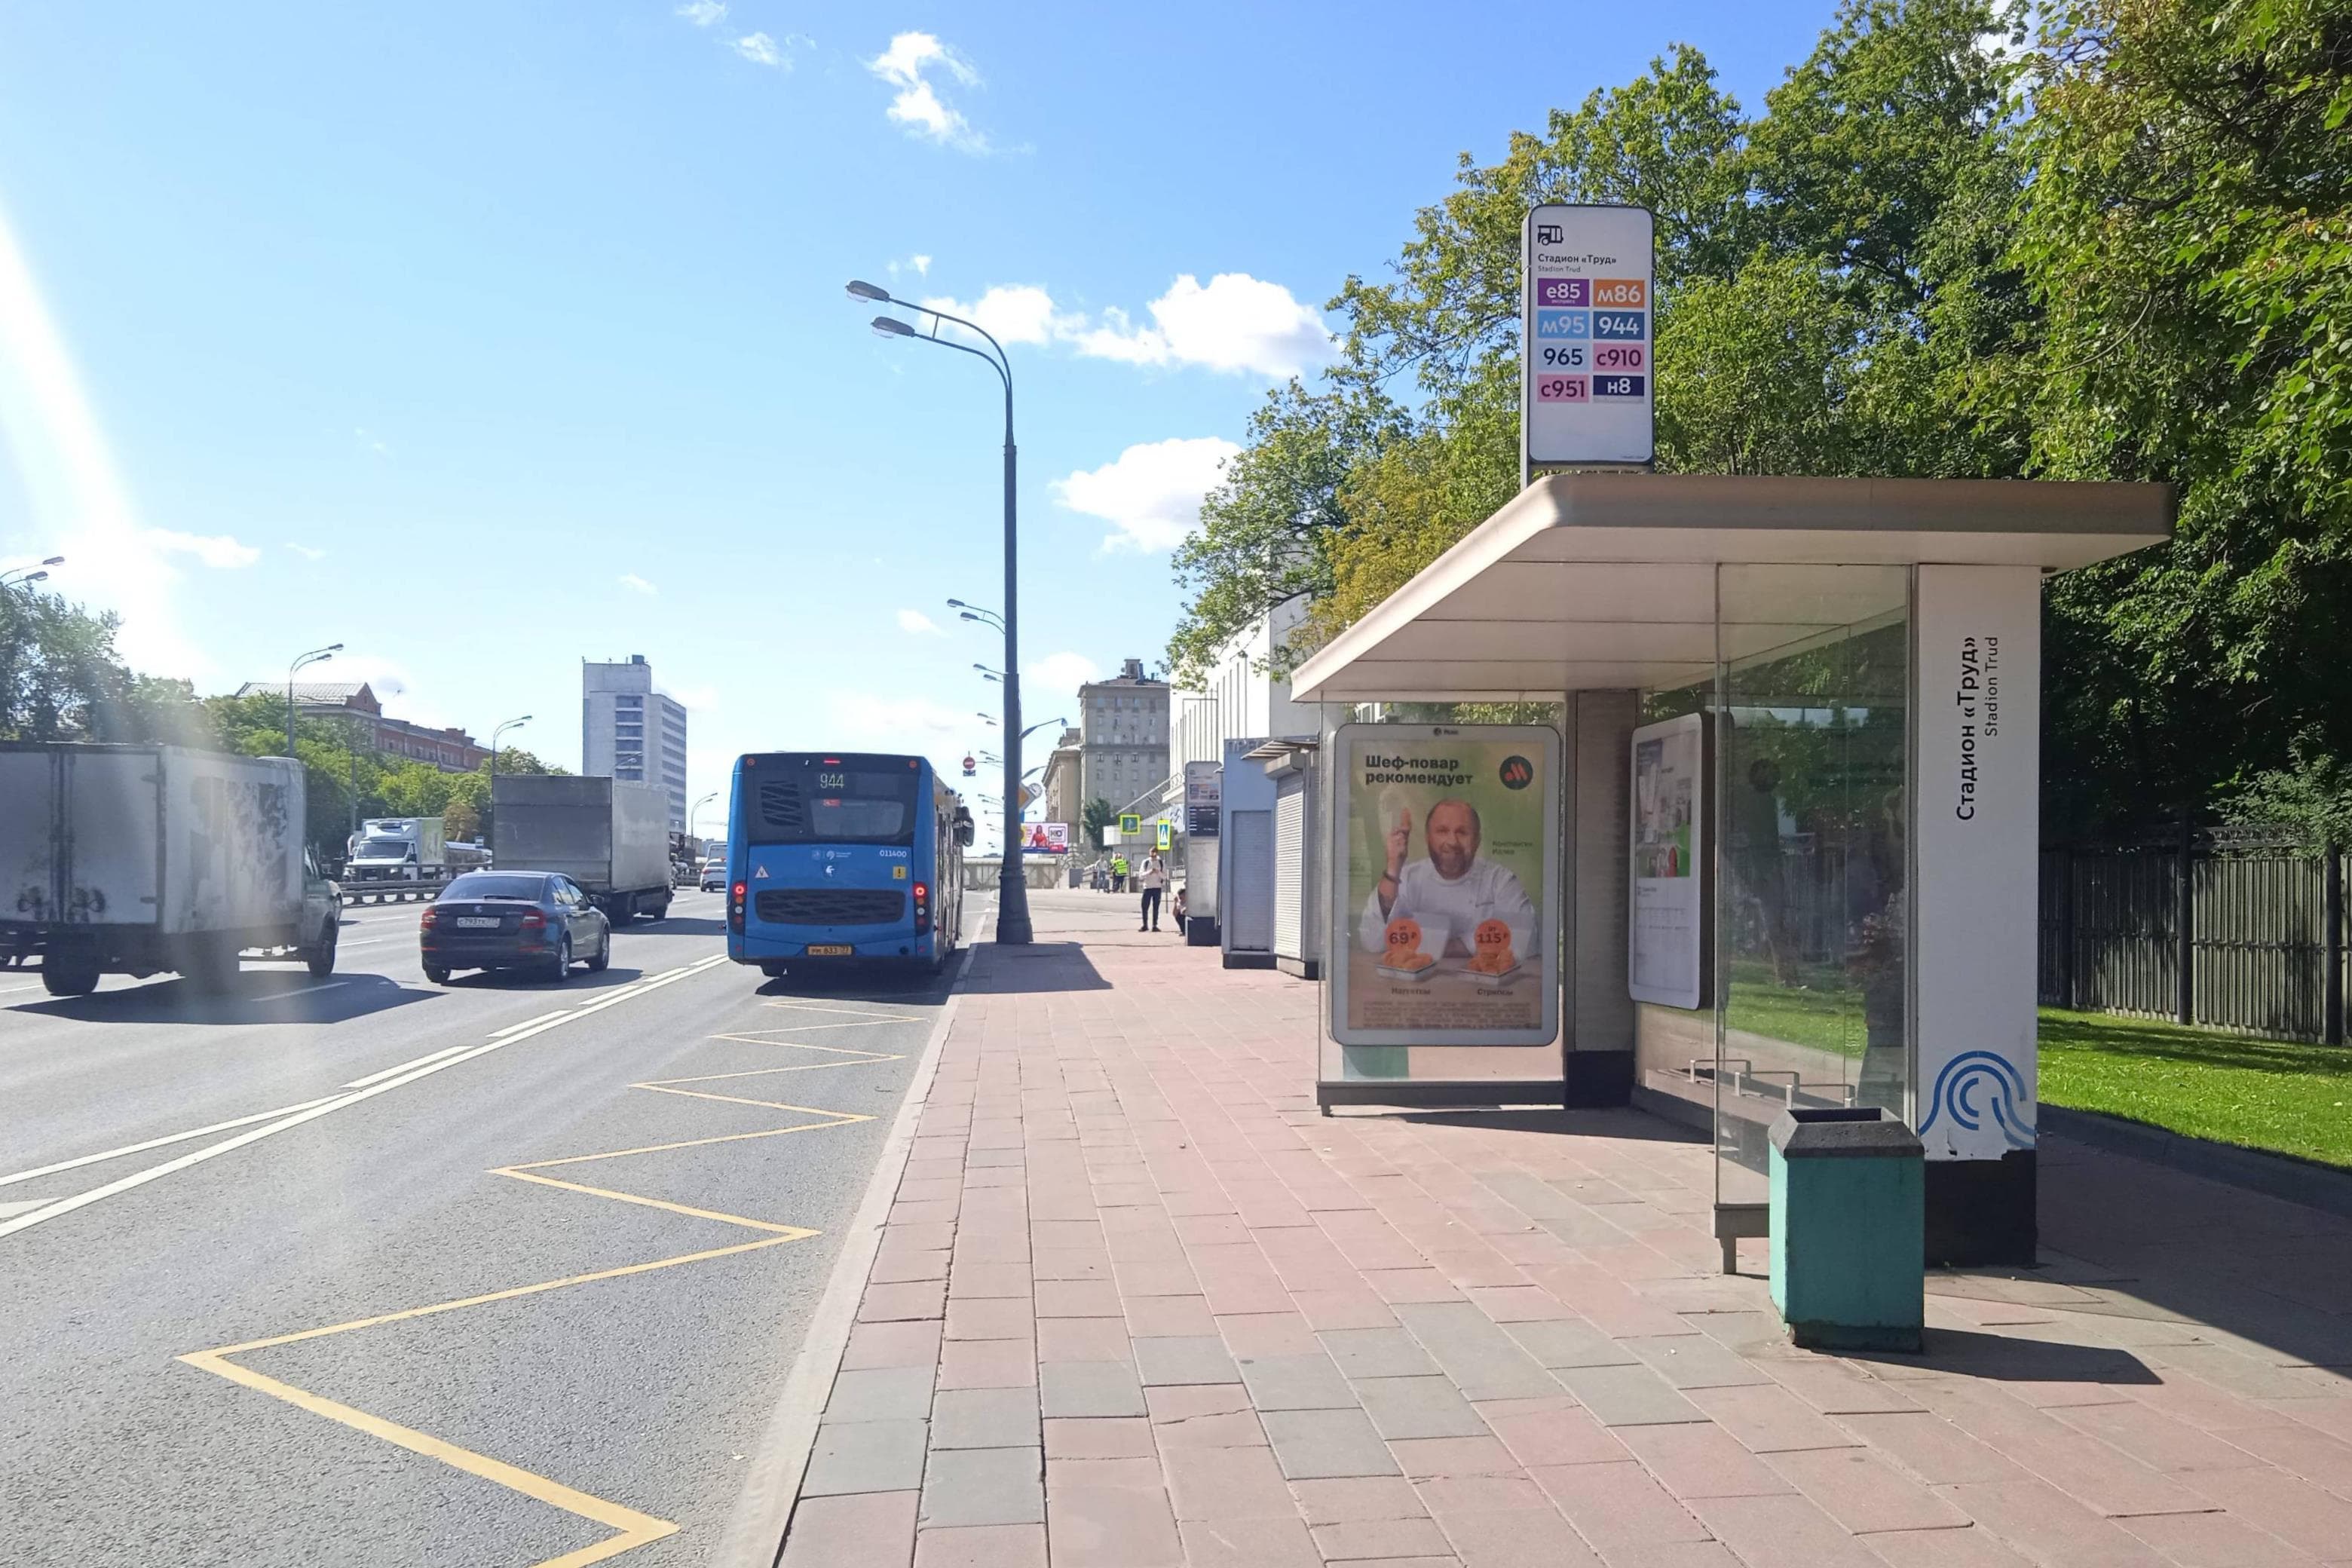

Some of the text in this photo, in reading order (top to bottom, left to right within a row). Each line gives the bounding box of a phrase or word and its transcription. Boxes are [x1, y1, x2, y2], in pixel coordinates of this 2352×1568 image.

[1538, 253, 1617, 265] Стадион «Труд»
[1598, 317, 1640, 335] 944
[1543, 348, 1583, 366] 965
[1984, 637, 1998, 737] Stadion Trud
[1956, 637, 1980, 821] Стадион «Труд»
[1365, 755, 1459, 771] Шеф-повар
[820, 773, 845, 789] 944
[1365, 773, 1474, 787] рекомендует
[879, 850, 908, 858] 011400
